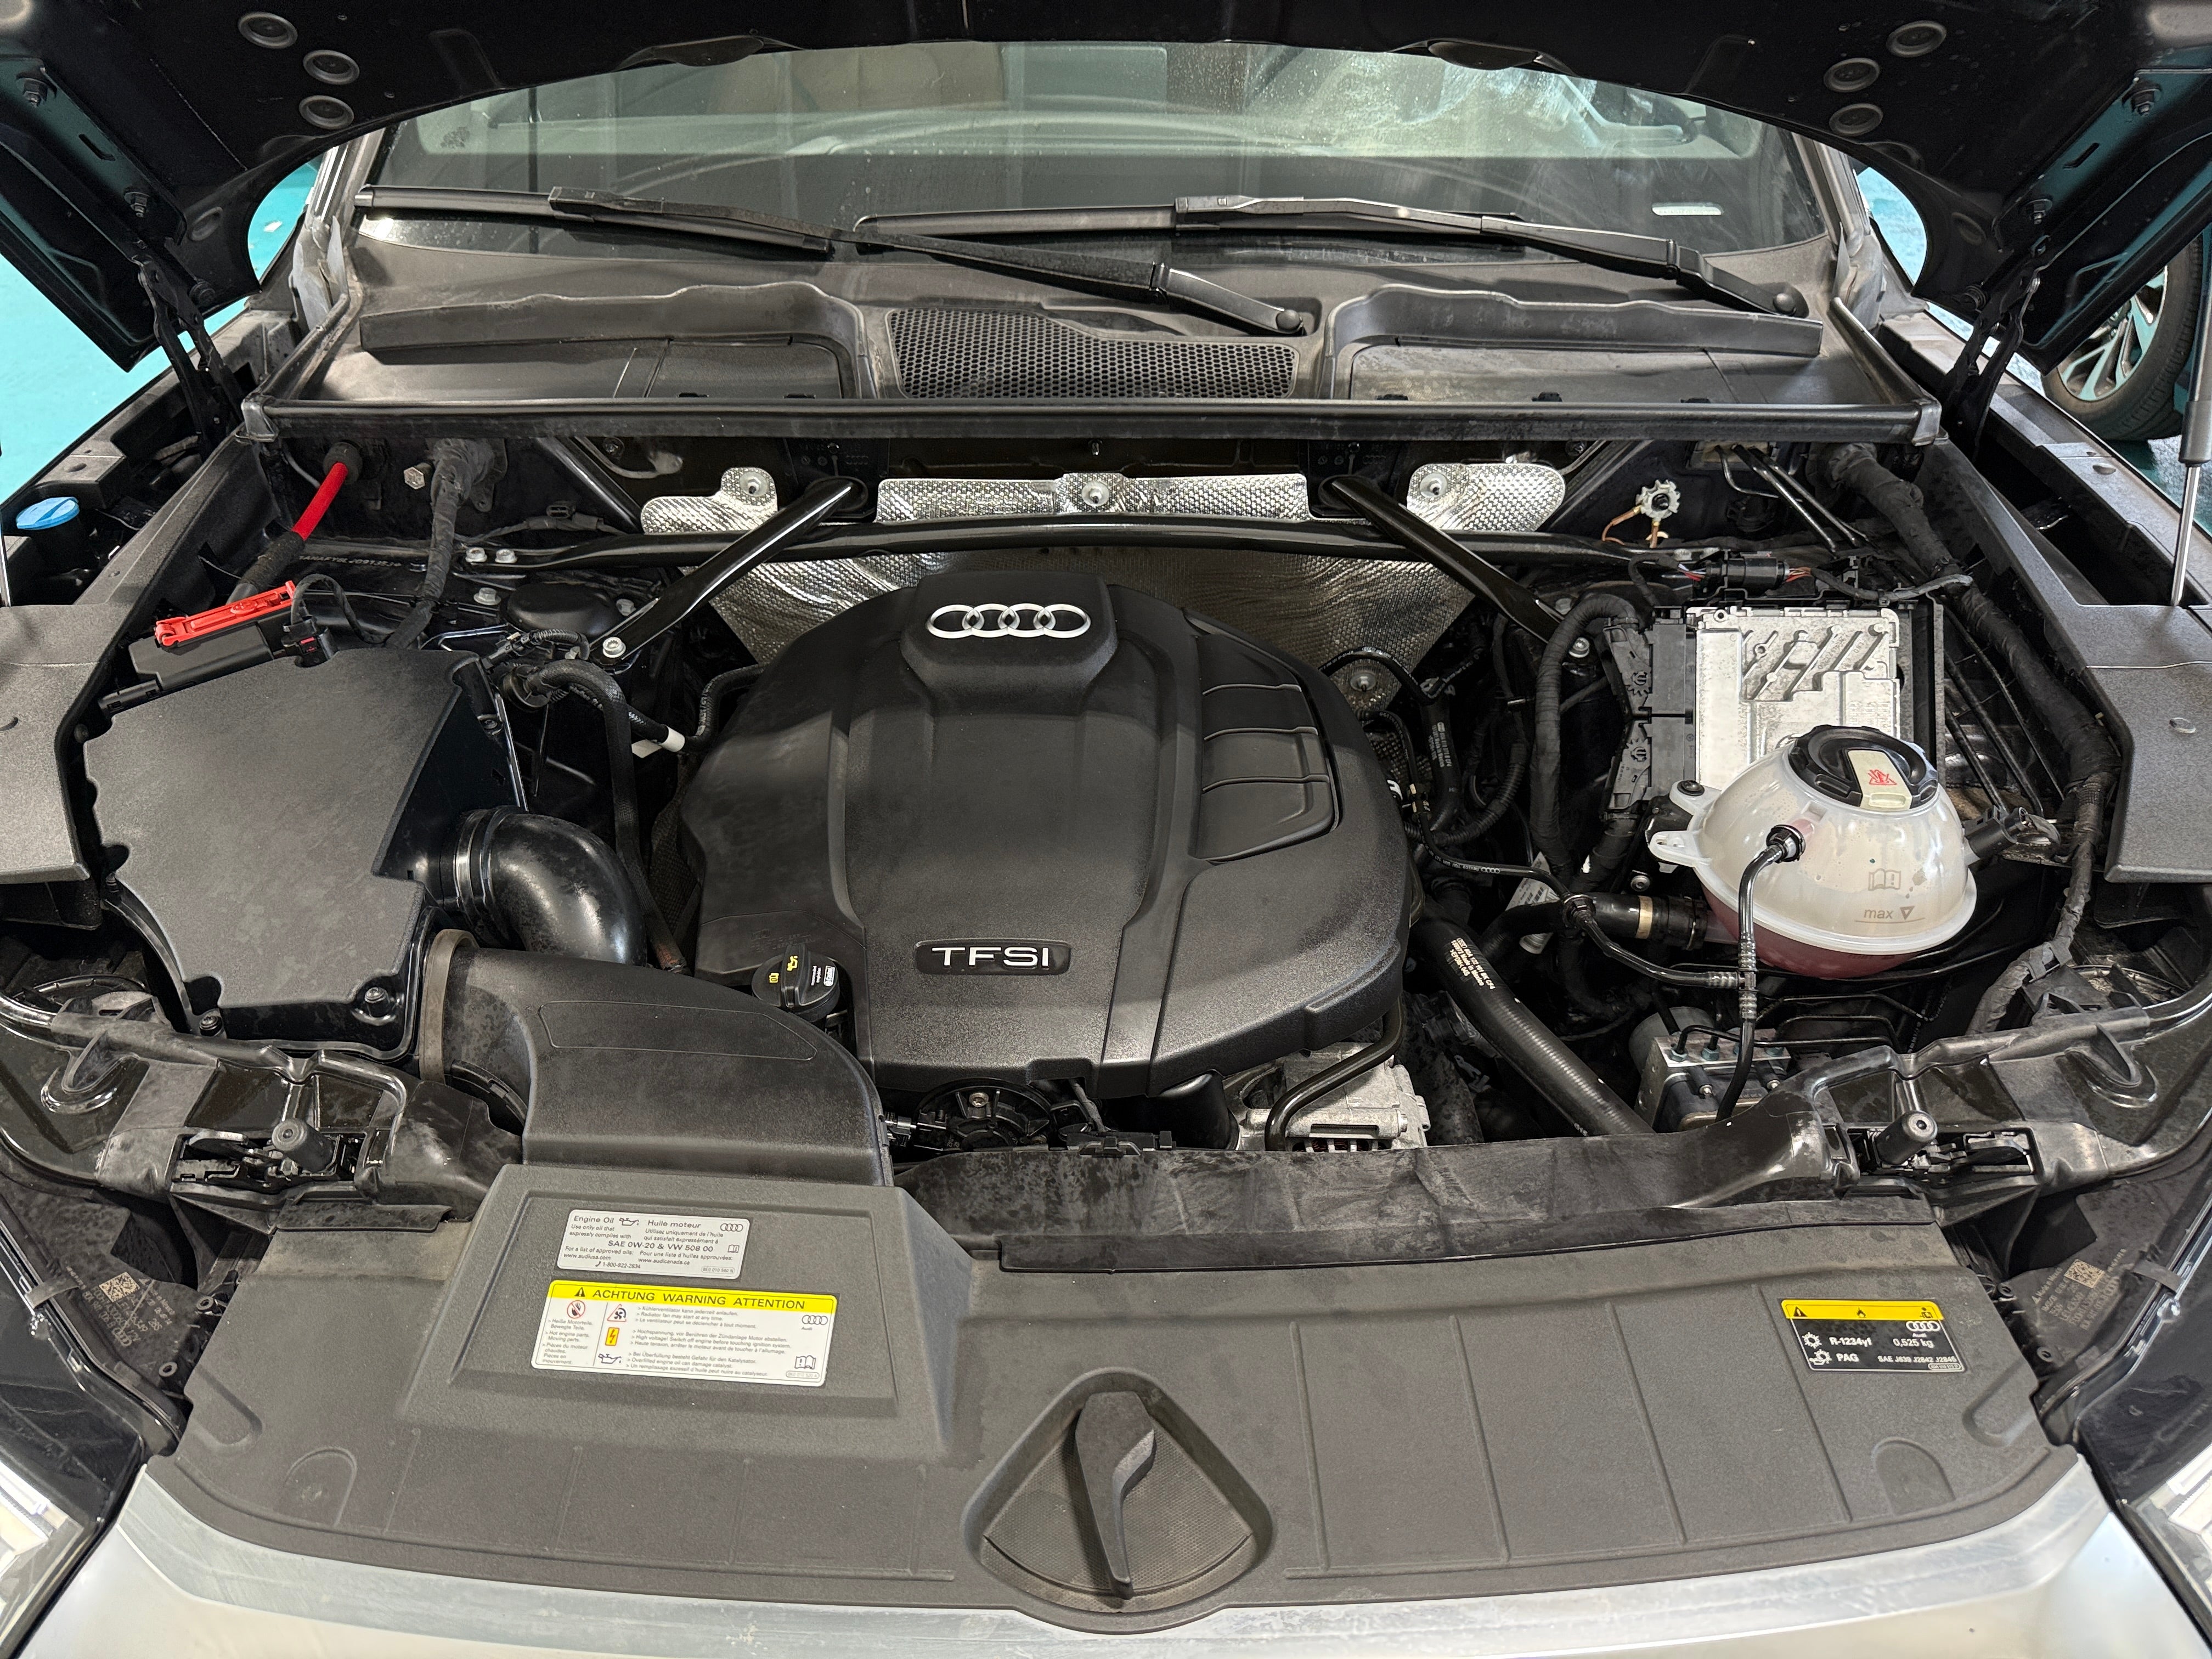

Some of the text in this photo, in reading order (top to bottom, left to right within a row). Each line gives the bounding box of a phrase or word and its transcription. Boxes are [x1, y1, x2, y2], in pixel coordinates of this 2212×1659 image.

[1864, 909, 1893, 919] max
[932, 947, 1049, 967] TFSI
[1471, 970, 1484, 986] Mexico
[573, 1216, 600, 1224] Engine
[592, 1290, 805, 1309] ACHTUNG WARNING ATTENTION
[1829, 1337, 1873, 1347] R-1234yf
[1893, 1338, 1934, 1348] 0,525 kg
[1836, 1353, 1859, 1362] PAG
